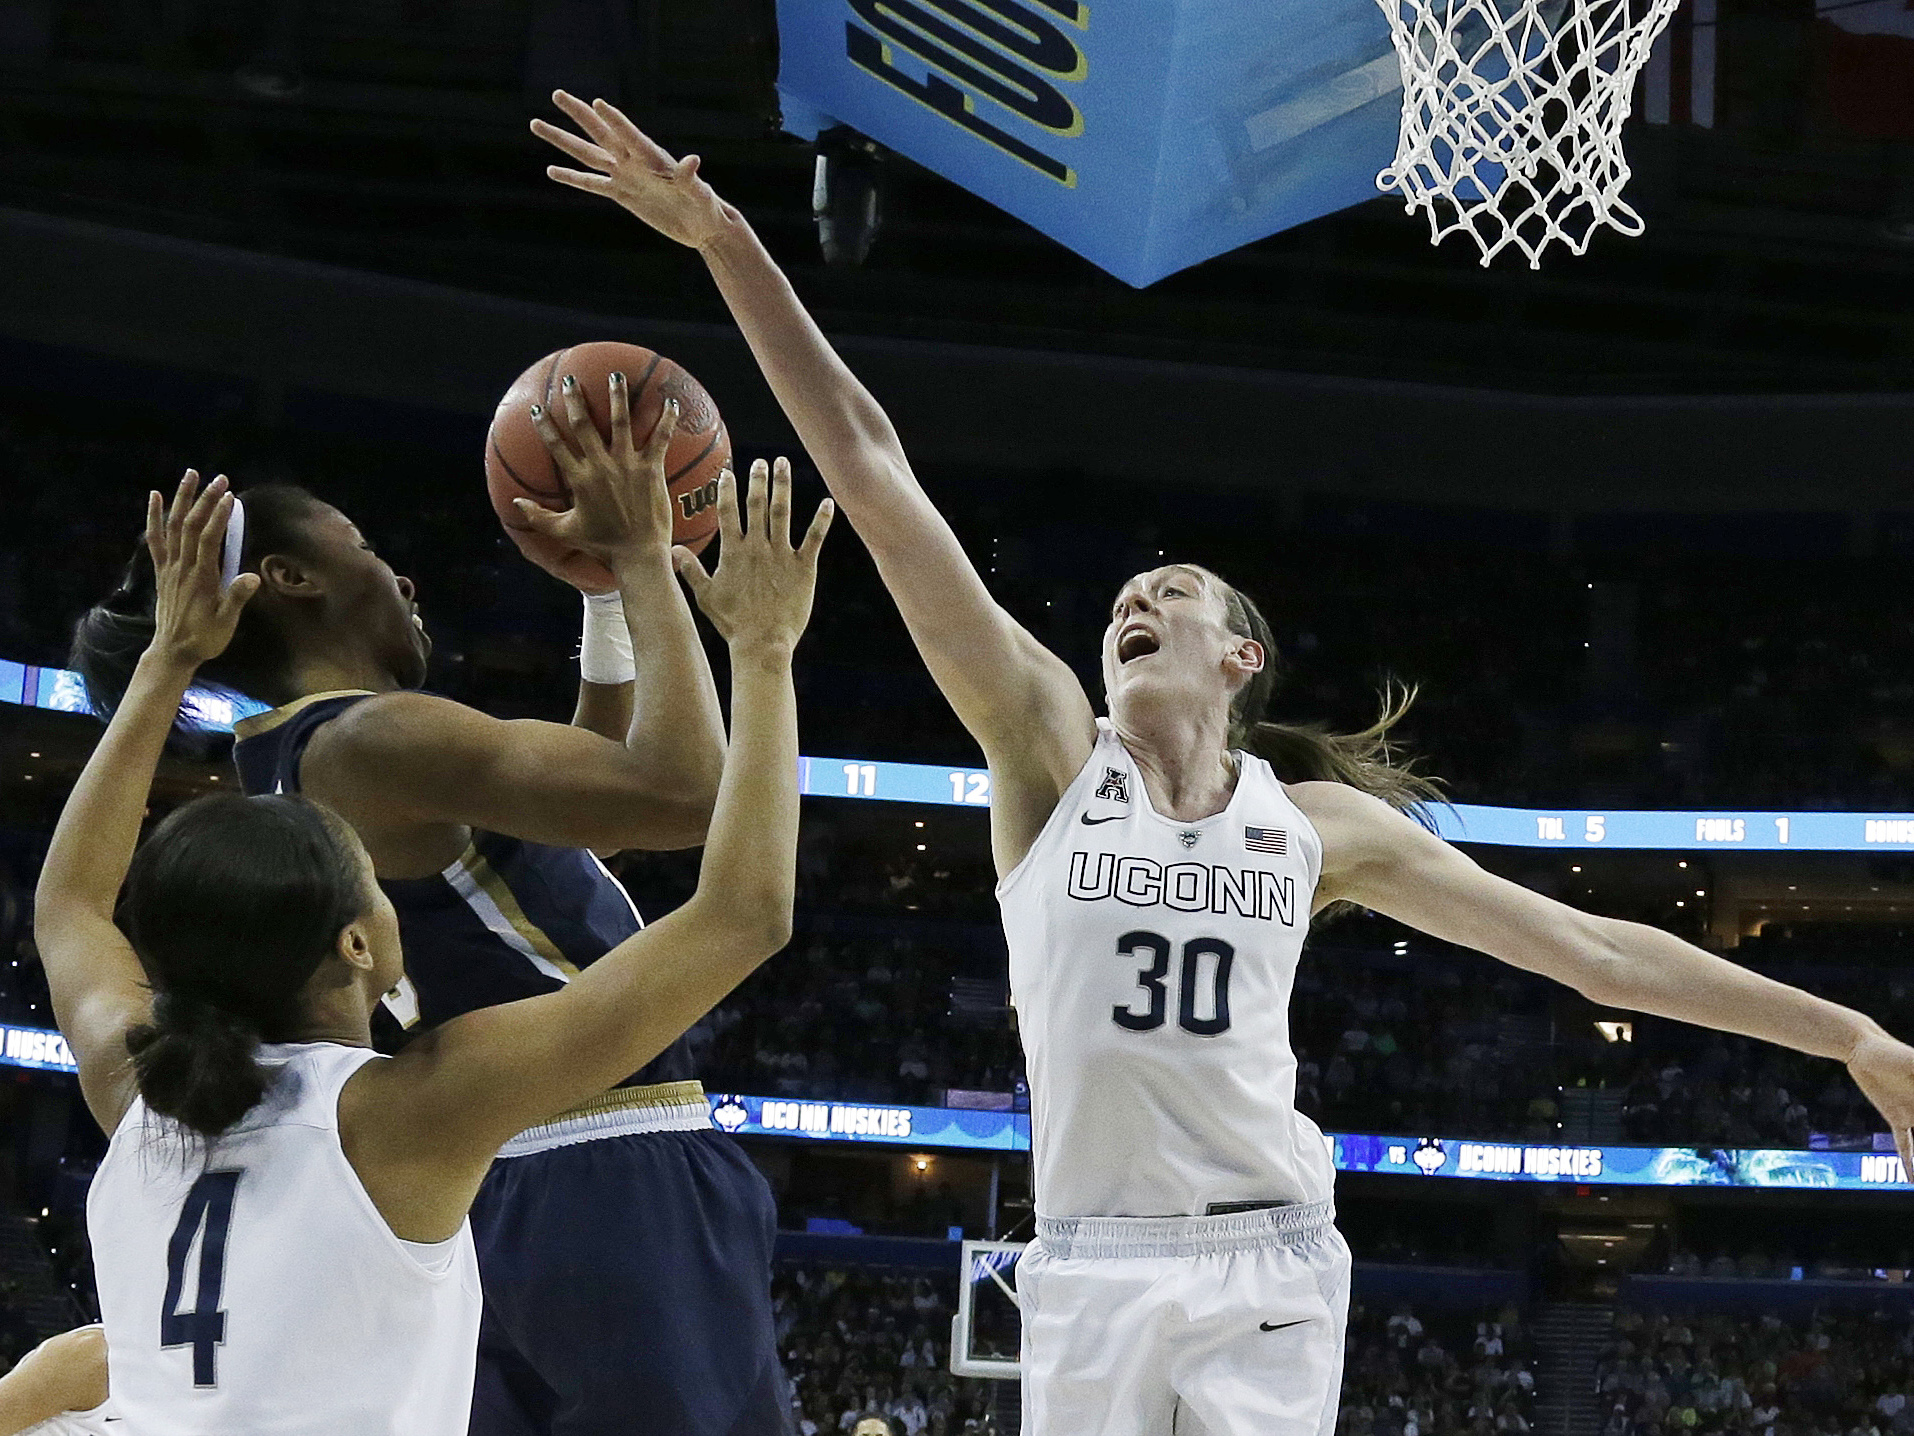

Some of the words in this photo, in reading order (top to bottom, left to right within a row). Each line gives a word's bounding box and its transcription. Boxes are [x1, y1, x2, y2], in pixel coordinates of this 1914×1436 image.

[845, 0, 1090, 188] FOU
[843, 764, 876, 796] 11
[949, 771, 990, 804] 12
[1536, 817, 1566, 840] TOL
[1585, 815, 1606, 842] 5
[1696, 818, 1745, 842] FOULS
[1775, 817, 1789, 844] 1
[1067, 852, 1294, 927] UCONN
[1111, 930, 1235, 1038] 30
[761, 1101, 829, 1132] UCONN
[830, 1106, 912, 1138] HUSKIES
[1459, 1144, 1521, 1173] UCONN
[1524, 1147, 1602, 1176] HUSKIES
[160, 1167, 245, 1389] 4
